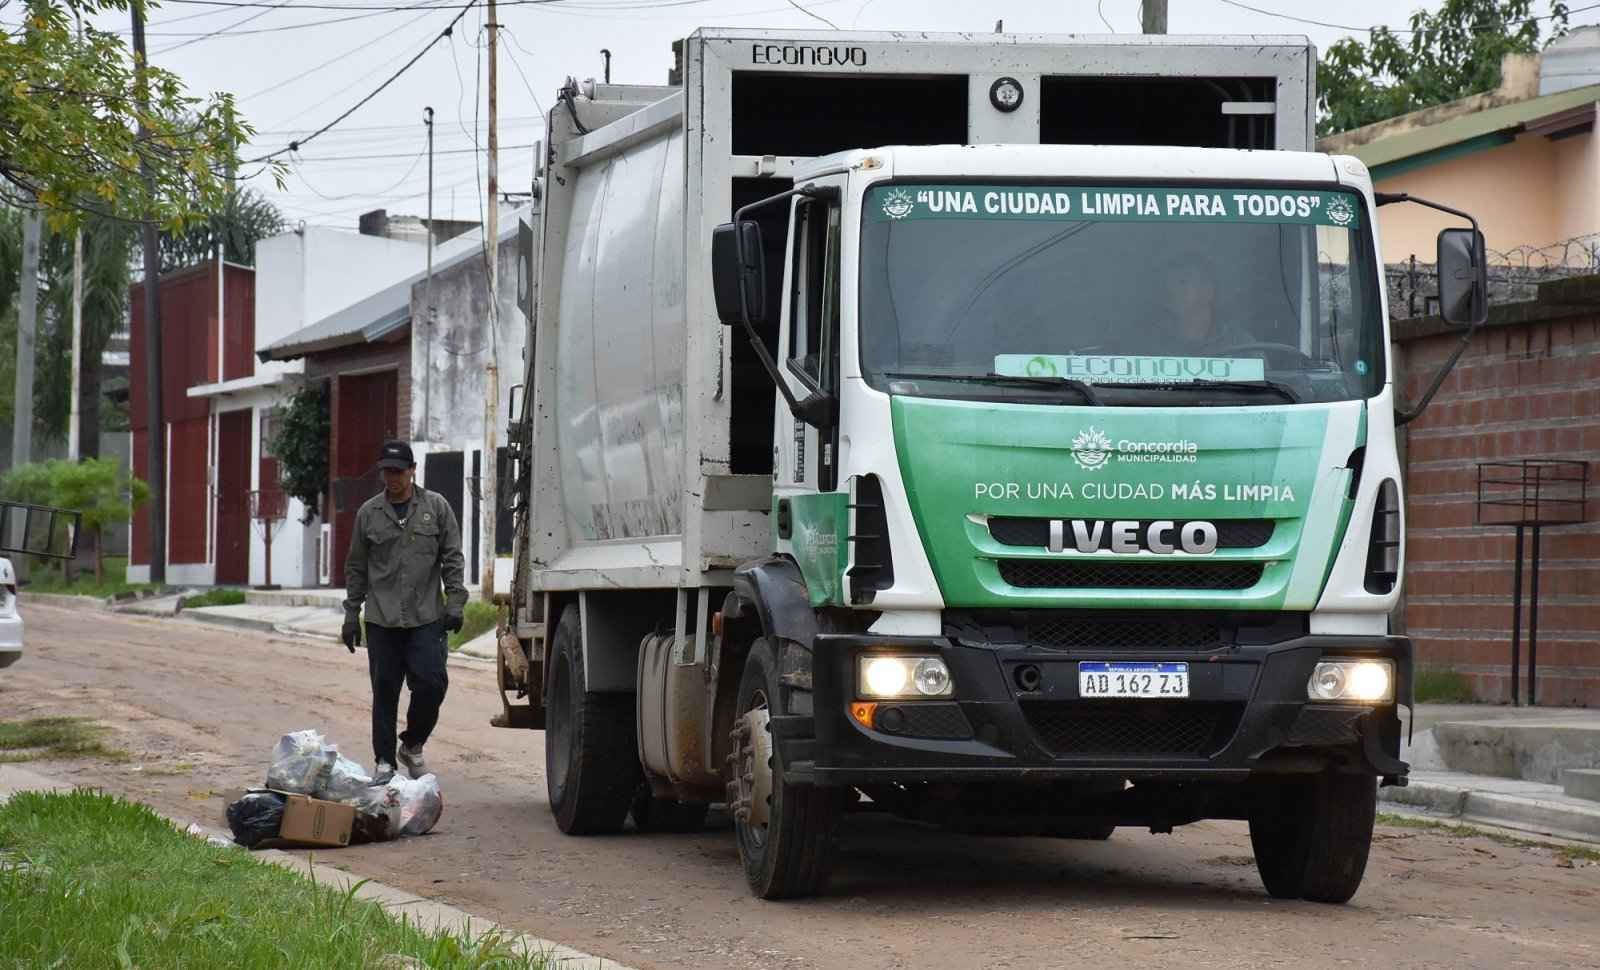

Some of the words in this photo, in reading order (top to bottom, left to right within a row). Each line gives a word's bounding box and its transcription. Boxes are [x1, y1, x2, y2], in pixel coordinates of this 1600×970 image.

[984, 192, 1070, 214] CIUDAD
[1082, 193, 1160, 216] LIMPIA
[1166, 194, 1226, 216] PARA
[1118, 440, 1198, 453] Concordia
[1118, 454, 1198, 464] MUNICIPALIDAD
[975, 483, 1018, 499] POR
[1027, 484, 1074, 499] UNA
[1081, 484, 1164, 500] CIUDAD
[1172, 480, 1217, 501] MÁS
[1224, 484, 1295, 502] LIMPIA
[1049, 520, 1218, 555] IVECO
[1086, 674, 1109, 694] AD
[1116, 674, 1151, 694] 162
[1160, 674, 1183, 694] ZJ
